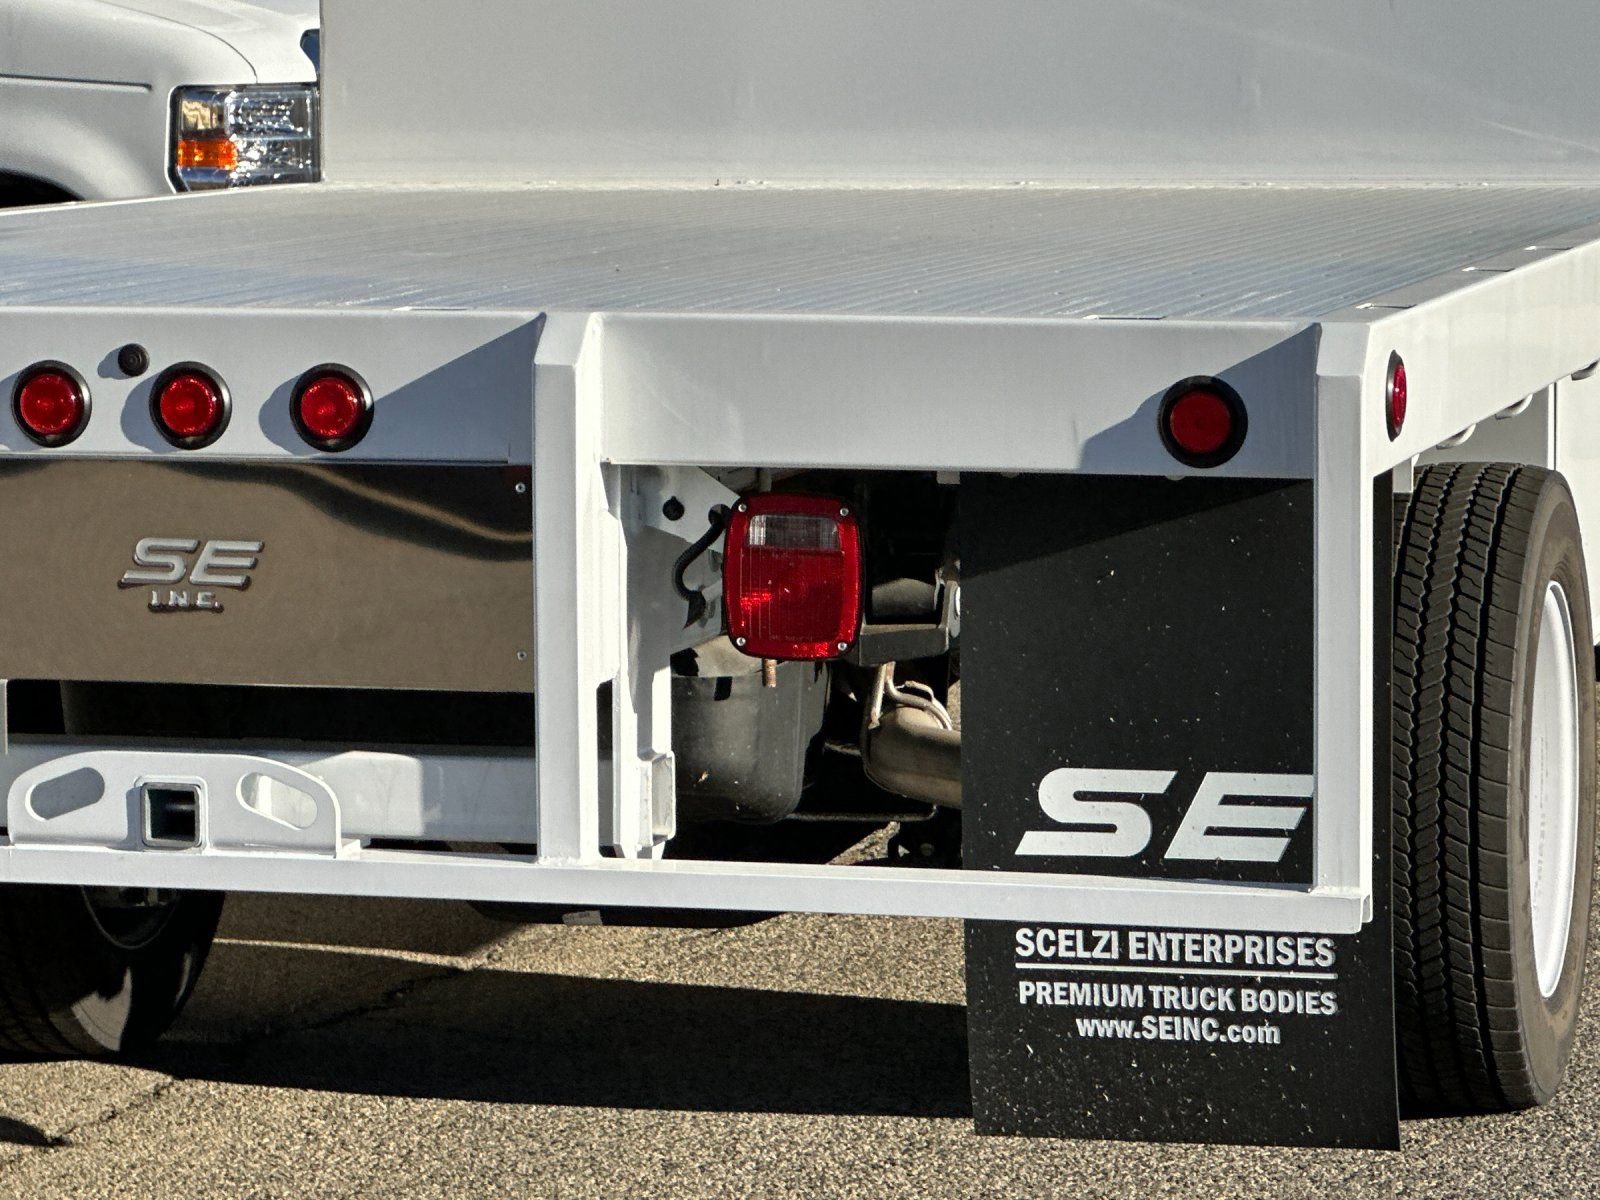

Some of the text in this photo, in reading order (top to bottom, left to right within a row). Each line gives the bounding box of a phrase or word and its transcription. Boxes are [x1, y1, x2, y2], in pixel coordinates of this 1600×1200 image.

[119, 537, 264, 588] SE
[1014, 767, 1314, 862] SE
[1015, 927, 1336, 968] SCELZI ENTERPRISES
[1018, 980, 1339, 1016] PREMIUM TRUCK BODIES
[1075, 1016, 1281, 1044] www.SEINC.com
